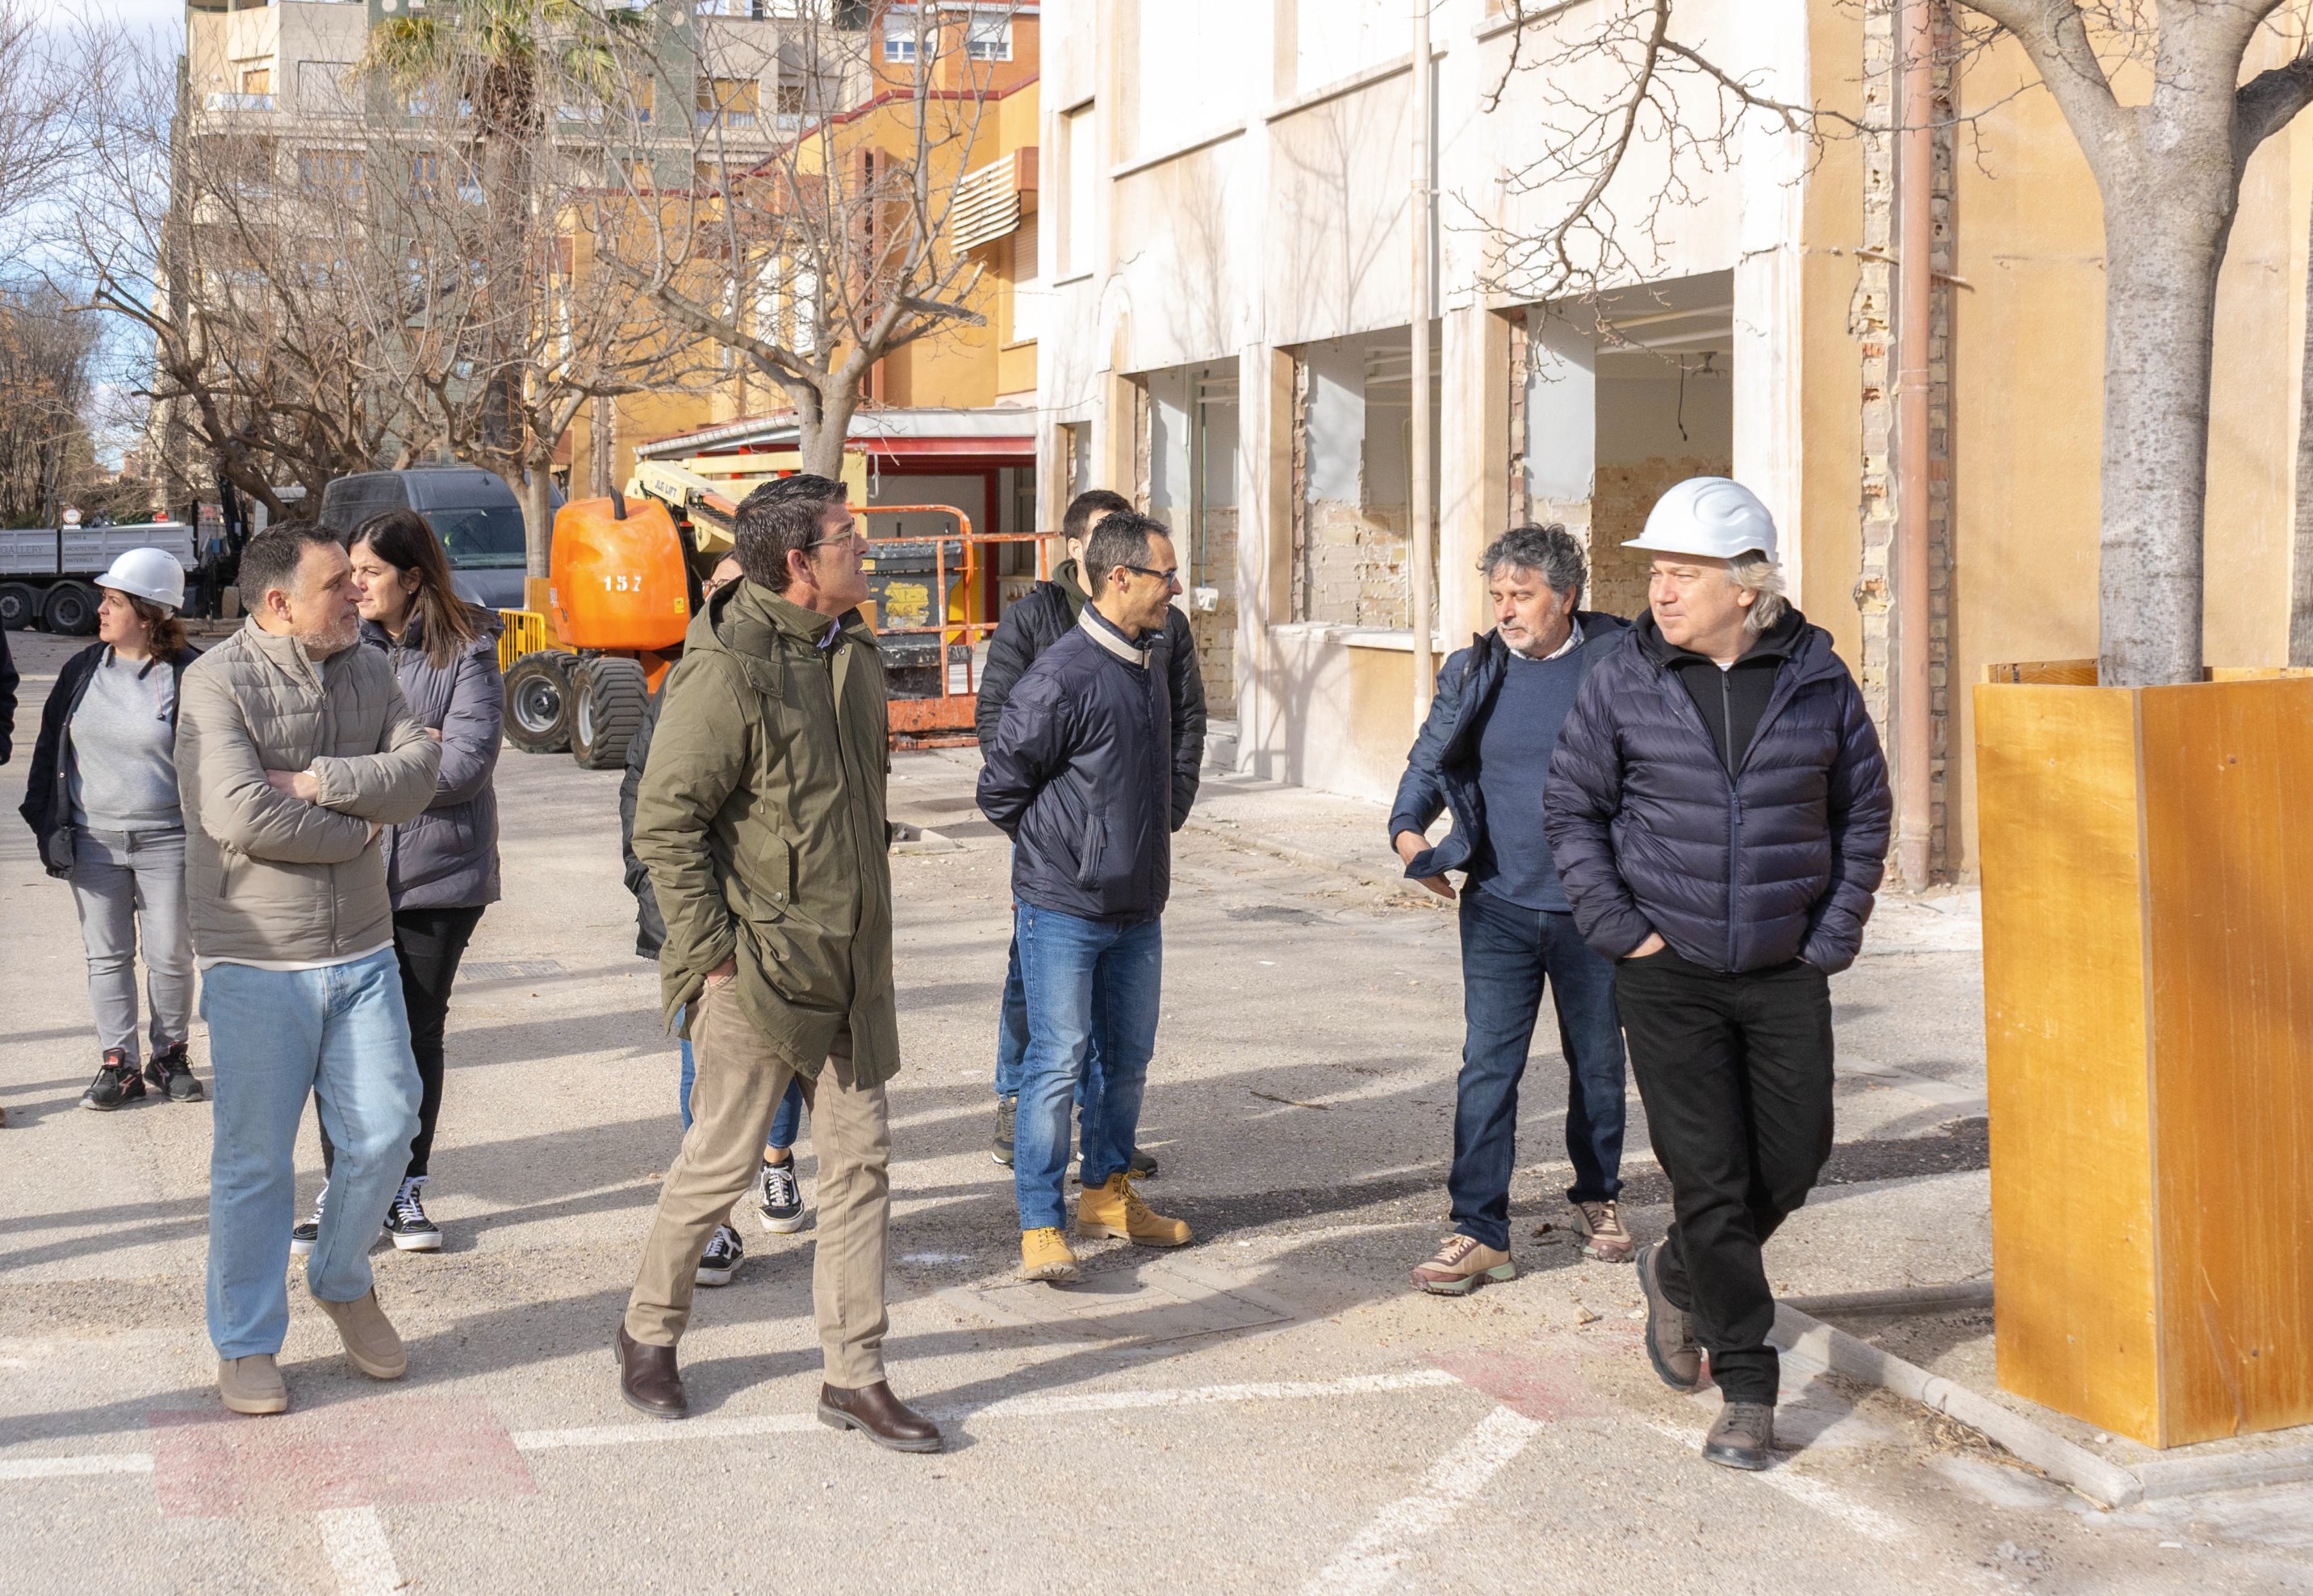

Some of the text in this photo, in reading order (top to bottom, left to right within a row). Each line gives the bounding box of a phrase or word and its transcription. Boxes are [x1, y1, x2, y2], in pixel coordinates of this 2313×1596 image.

[665, 484, 677, 497] LIFT
[1, 545, 44, 555] GALLERY
[604, 574, 642, 592] 157
